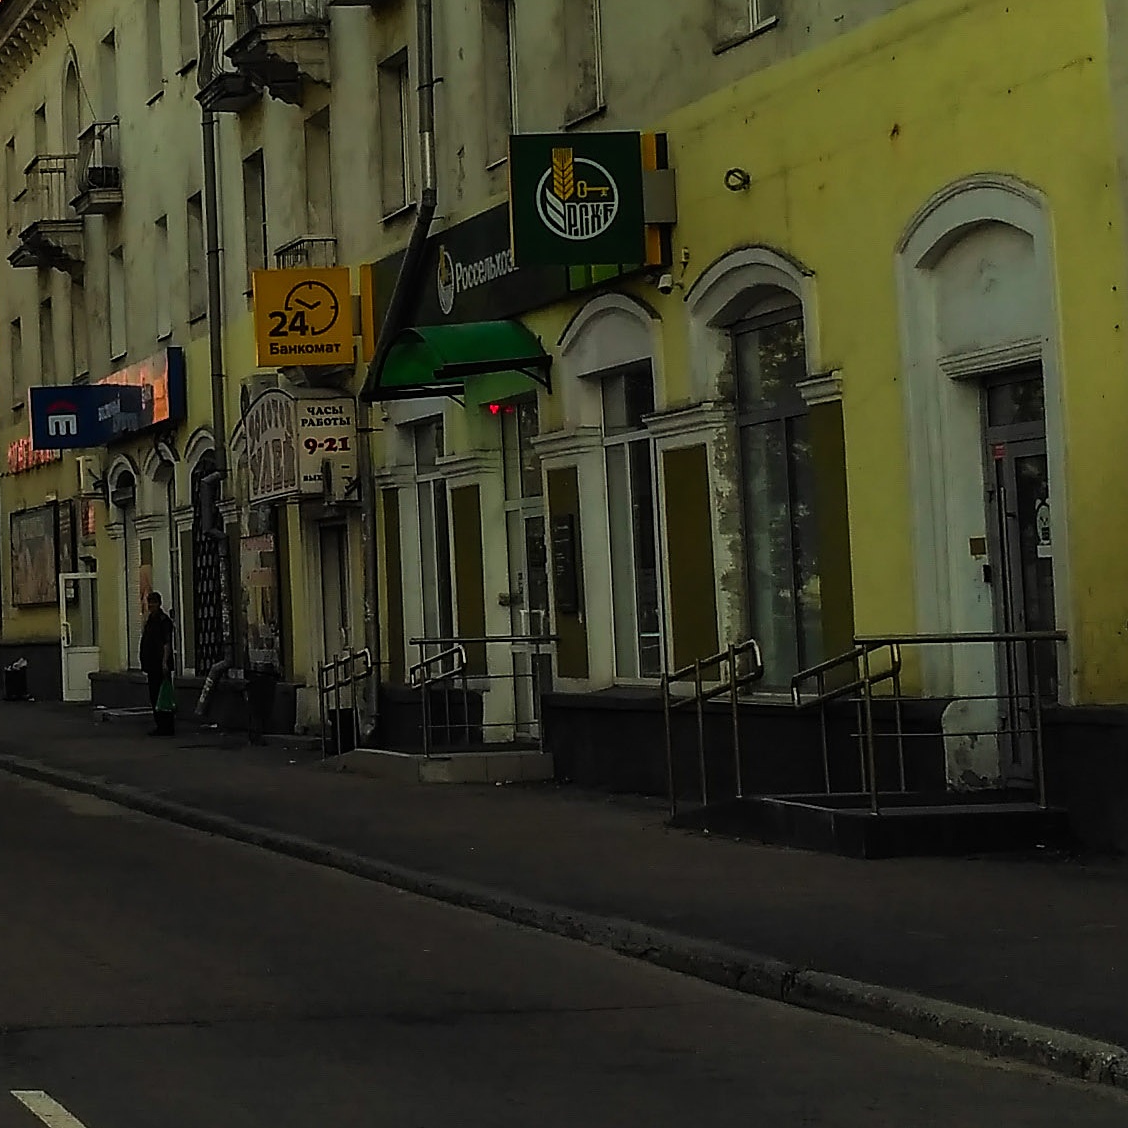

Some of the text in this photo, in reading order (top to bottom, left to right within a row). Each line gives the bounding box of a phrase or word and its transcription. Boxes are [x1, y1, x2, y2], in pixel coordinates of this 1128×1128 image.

[455, 248, 520, 293] Россельхоз
[268, 311, 309, 337] 24
[270, 342, 341, 355] Банкомат
[307, 405, 344, 416] ЧАСЫ
[301, 417, 351, 427] РАБОТЫ
[304, 437, 351, 455] 9-21
